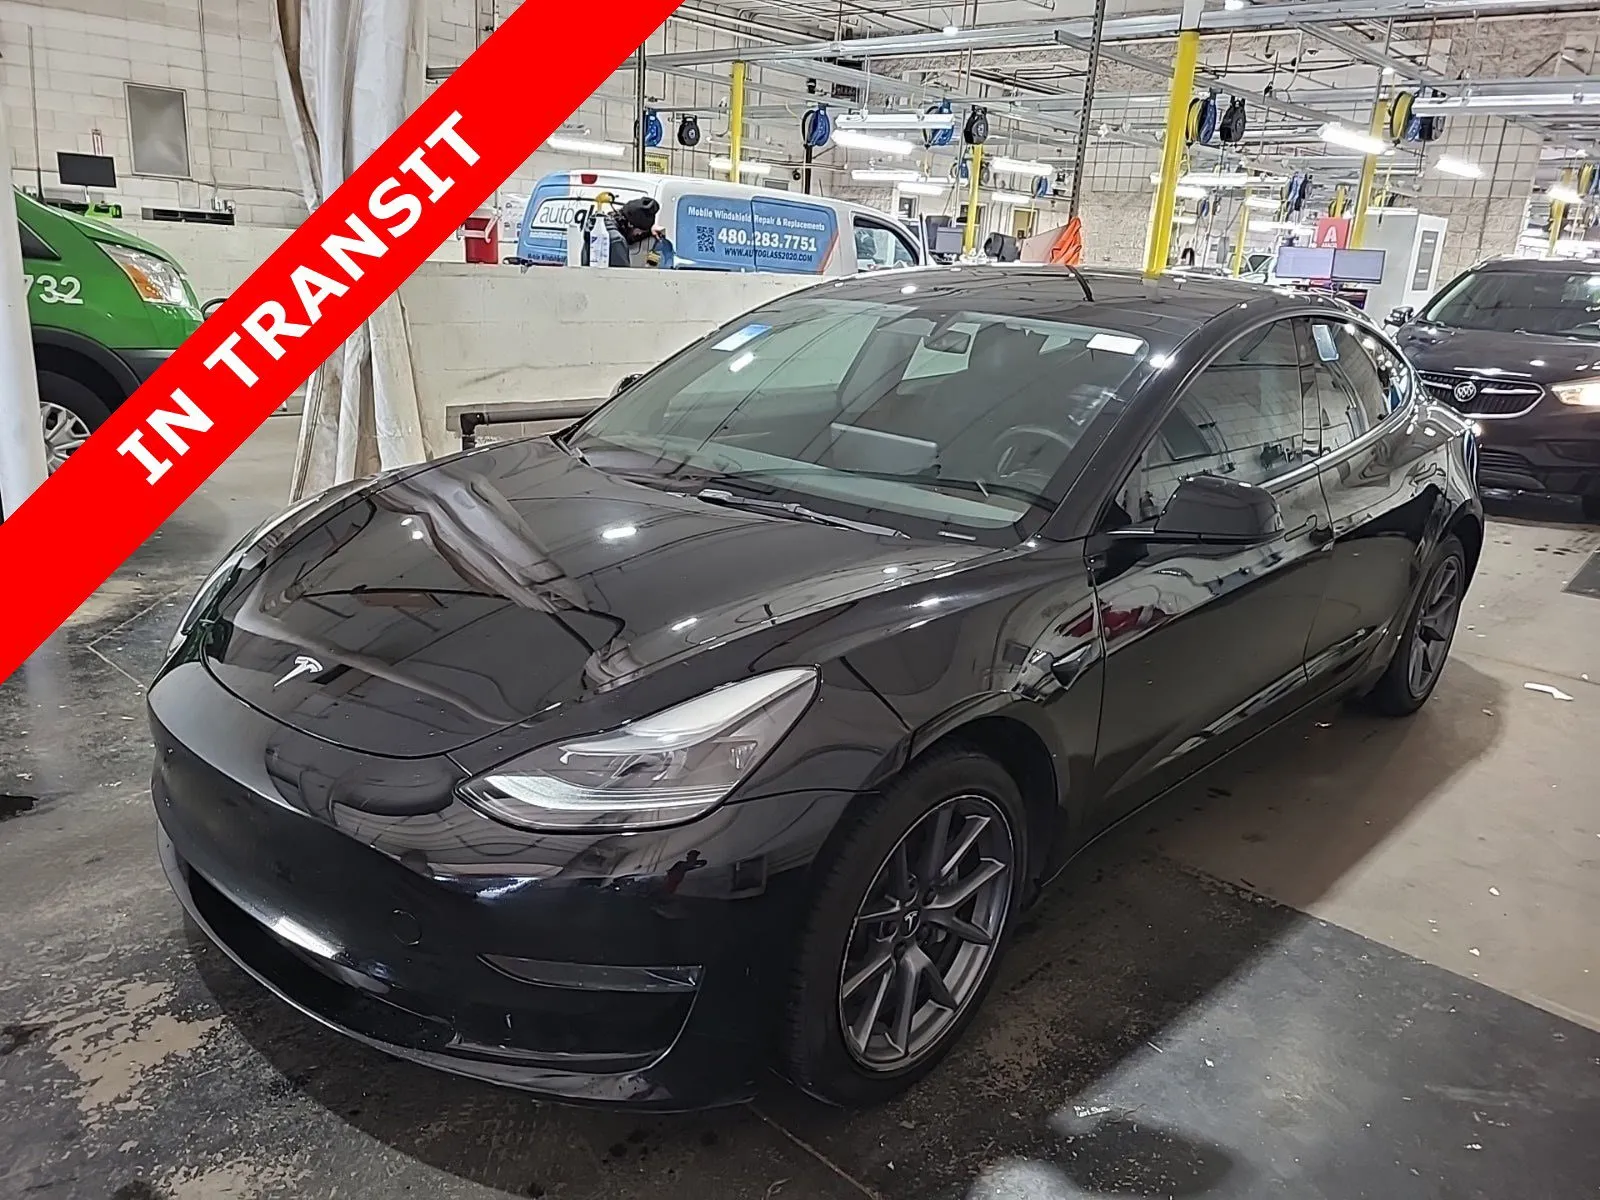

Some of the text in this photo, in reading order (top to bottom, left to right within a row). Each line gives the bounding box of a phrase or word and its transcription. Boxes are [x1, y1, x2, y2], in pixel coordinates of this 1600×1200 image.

[539, 204, 595, 233] autogl
[687, 205, 713, 218] Mobile
[714, 209, 751, 223] Windshield
[754, 214, 775, 226] Repair
[782, 218, 826, 232] Replacements
[717, 227, 817, 252] 480.283.7751
[724, 247, 813, 263] WWW.AUTOGLASS2020.COM
